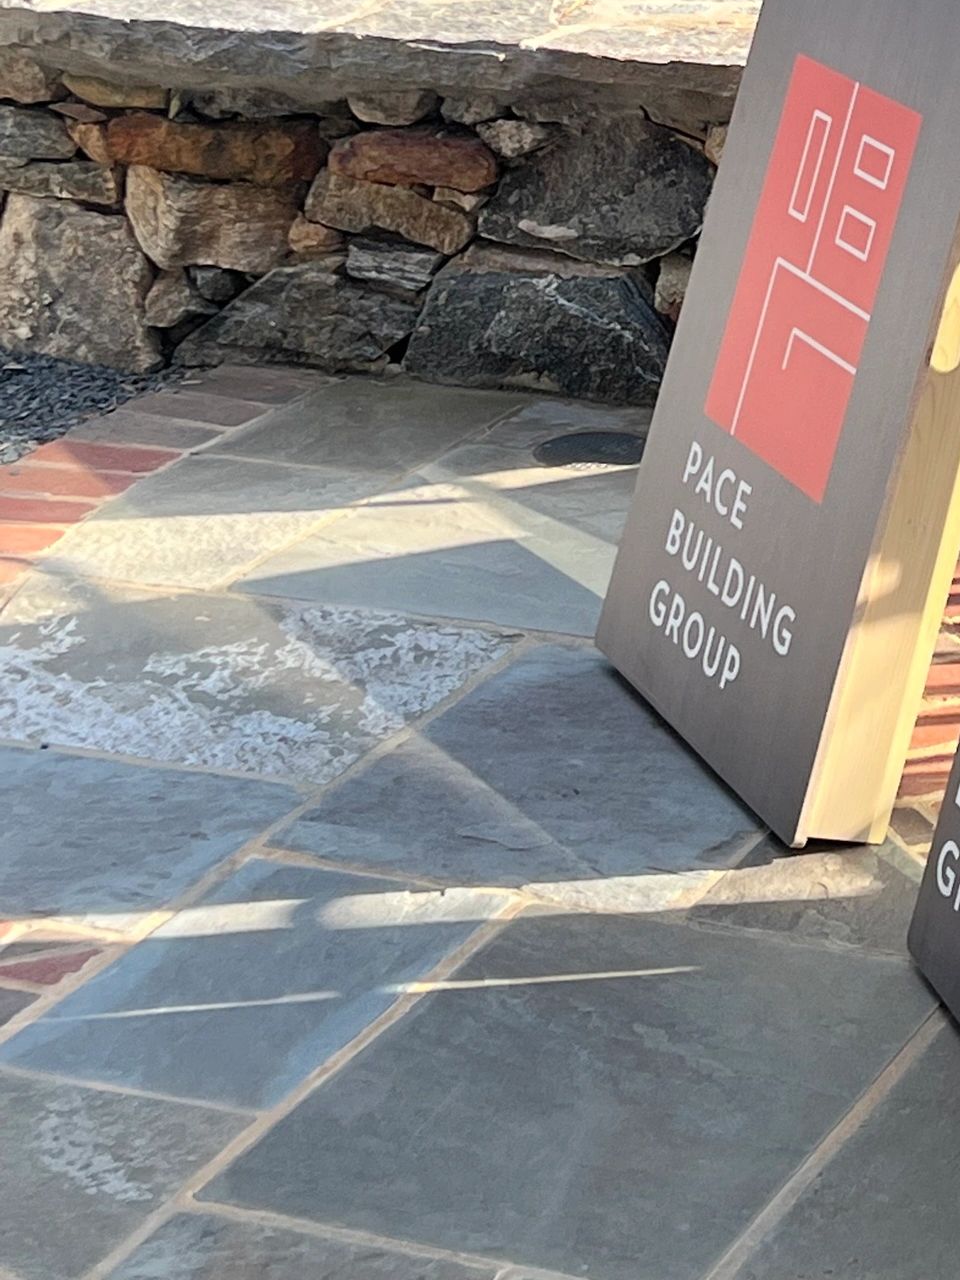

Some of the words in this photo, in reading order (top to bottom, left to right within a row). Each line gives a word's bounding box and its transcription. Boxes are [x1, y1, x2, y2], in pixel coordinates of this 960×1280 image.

[682, 441, 752, 530] PACE
[650, 580, 741, 689] GROUP
[665, 509, 796, 656] BUILDING
